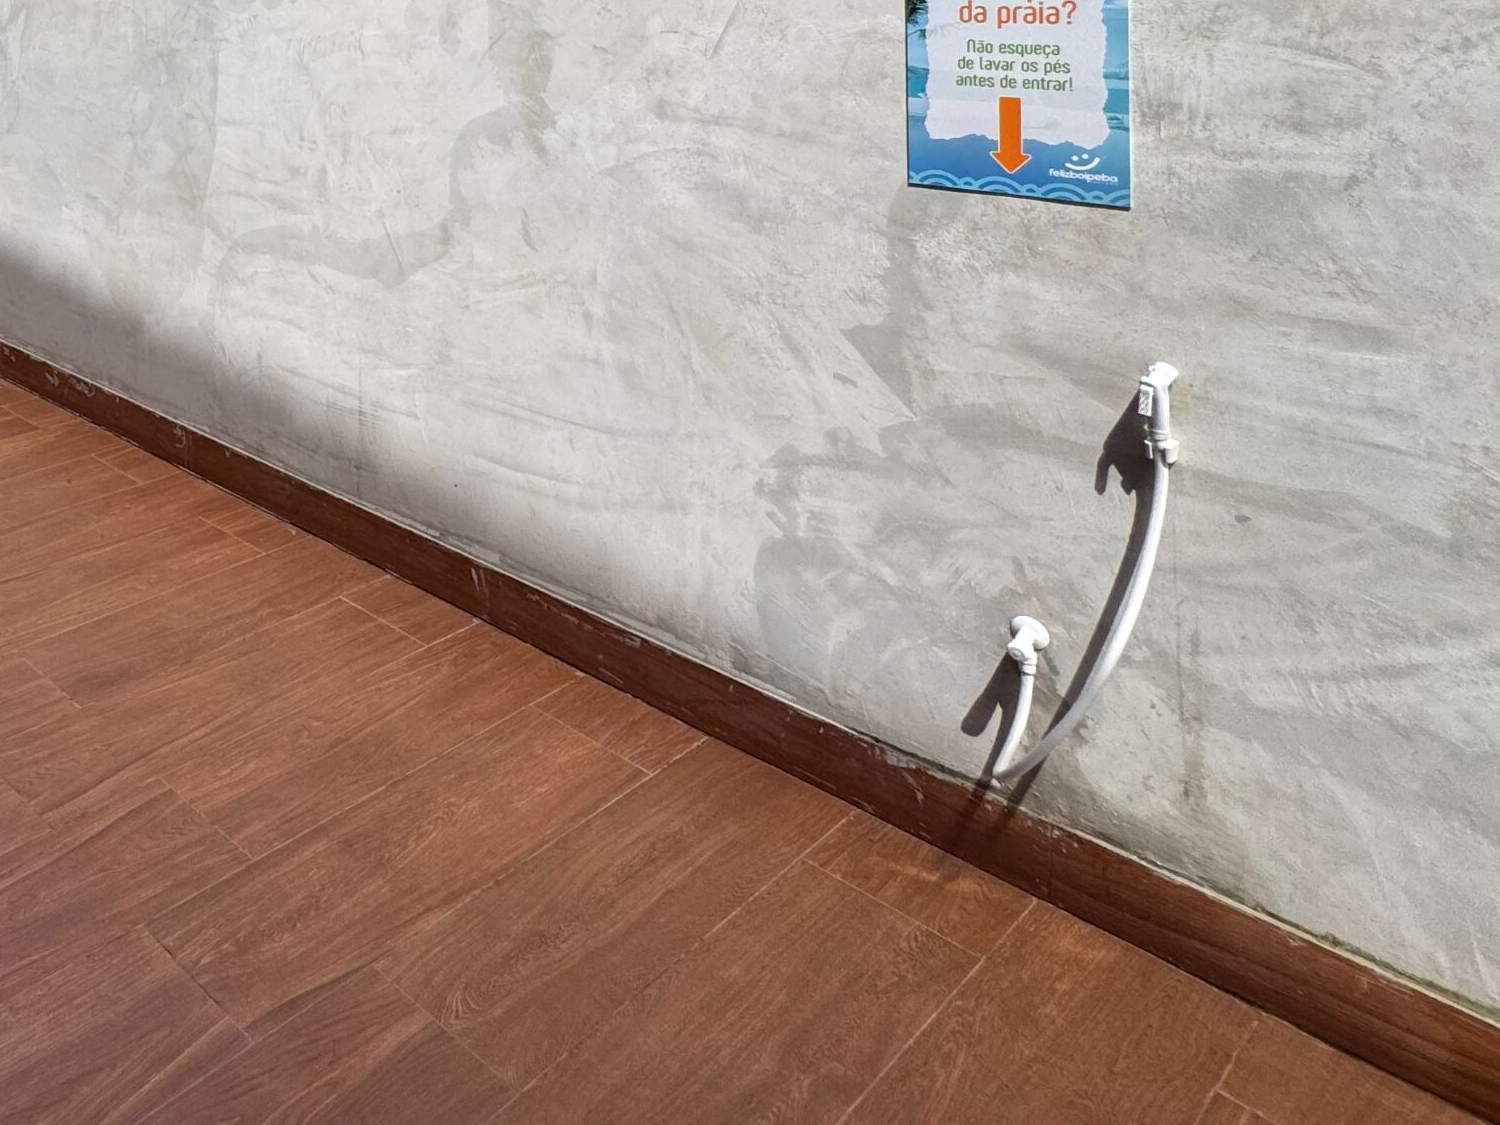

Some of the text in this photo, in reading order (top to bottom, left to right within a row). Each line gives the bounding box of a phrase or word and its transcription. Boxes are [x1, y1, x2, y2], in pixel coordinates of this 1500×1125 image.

[959, 0, 1077, 28] da praia?
[966, 38, 1060, 59] Não esqueça
[957, 56, 1071, 76] de lavar os pés
[956, 74, 1074, 92] antes de entrar!
[1049, 168, 1118, 183] felizboipeba
